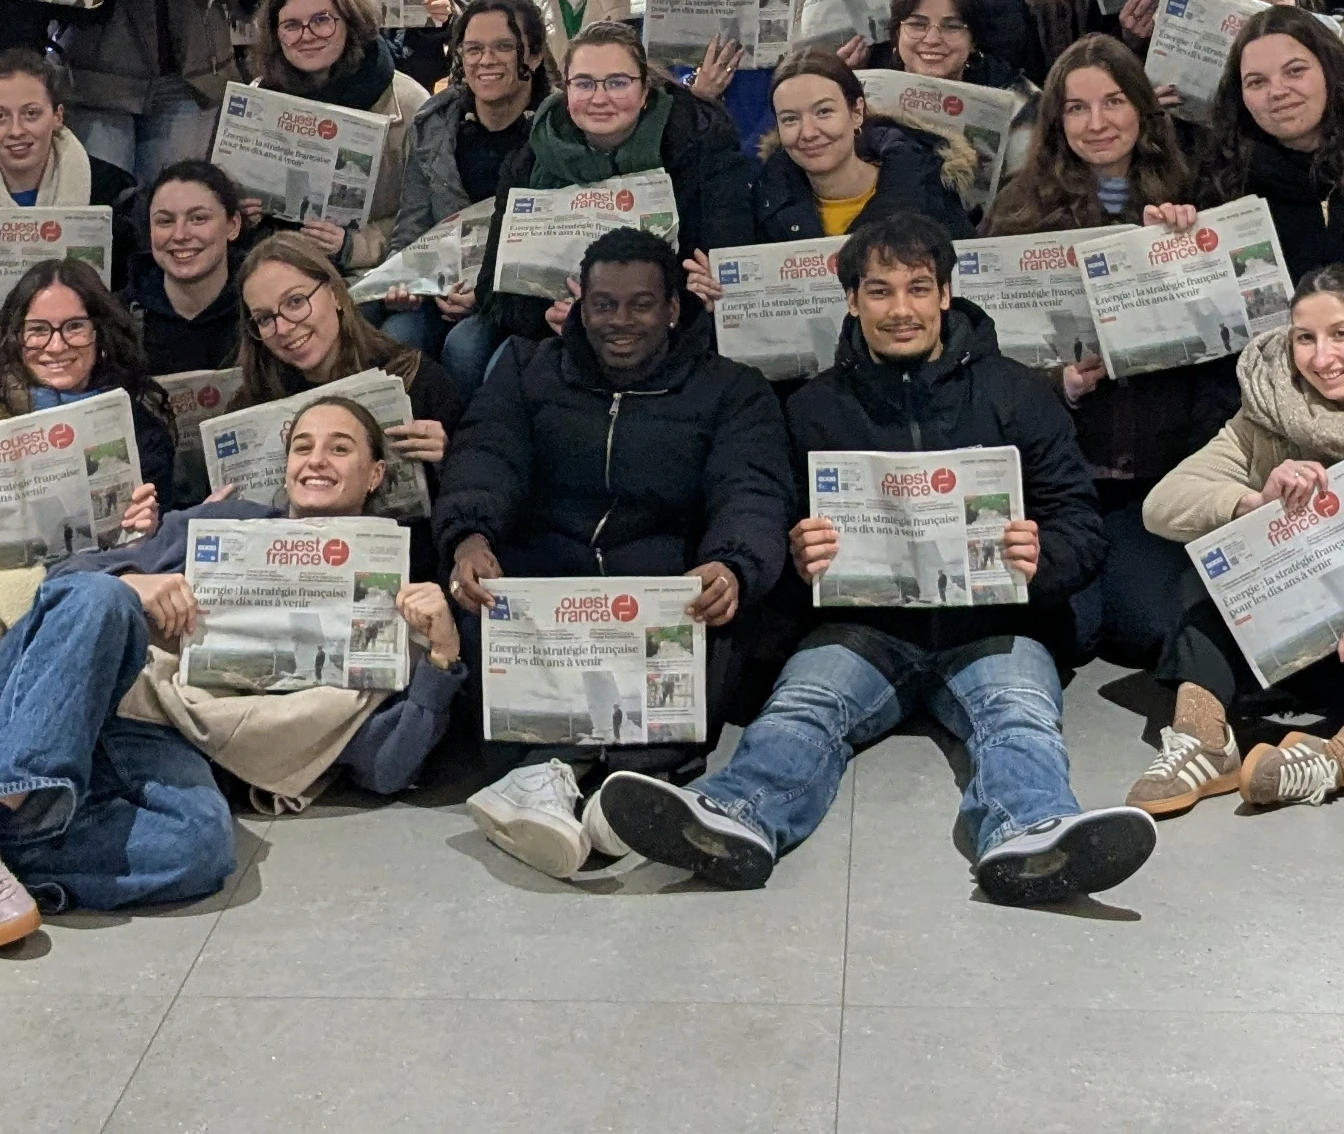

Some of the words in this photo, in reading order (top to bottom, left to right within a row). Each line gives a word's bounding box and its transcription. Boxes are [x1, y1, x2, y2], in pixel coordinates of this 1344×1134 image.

[277, 116, 316, 136] france
[282, 111, 317, 127] ouest
[576, 190, 614, 202] ouest
[570, 199, 615, 211] france
[2, 221, 38, 232] ouest
[1151, 233, 1194, 254] ouest
[1023, 245, 1064, 260] ouest
[1148, 245, 1198, 266] france
[783, 253, 825, 269] ouest
[1019, 257, 1066, 272] france
[779, 265, 827, 280] france
[0, 427, 45, 450] ouest
[884, 470, 929, 485] ouest
[881, 480, 931, 497] france
[1268, 504, 1313, 532] ouest
[1267, 514, 1320, 546] france
[272, 537, 320, 553] ouest
[265, 549, 321, 565] france
[560, 594, 609, 610] ouest
[554, 606, 611, 623] france
